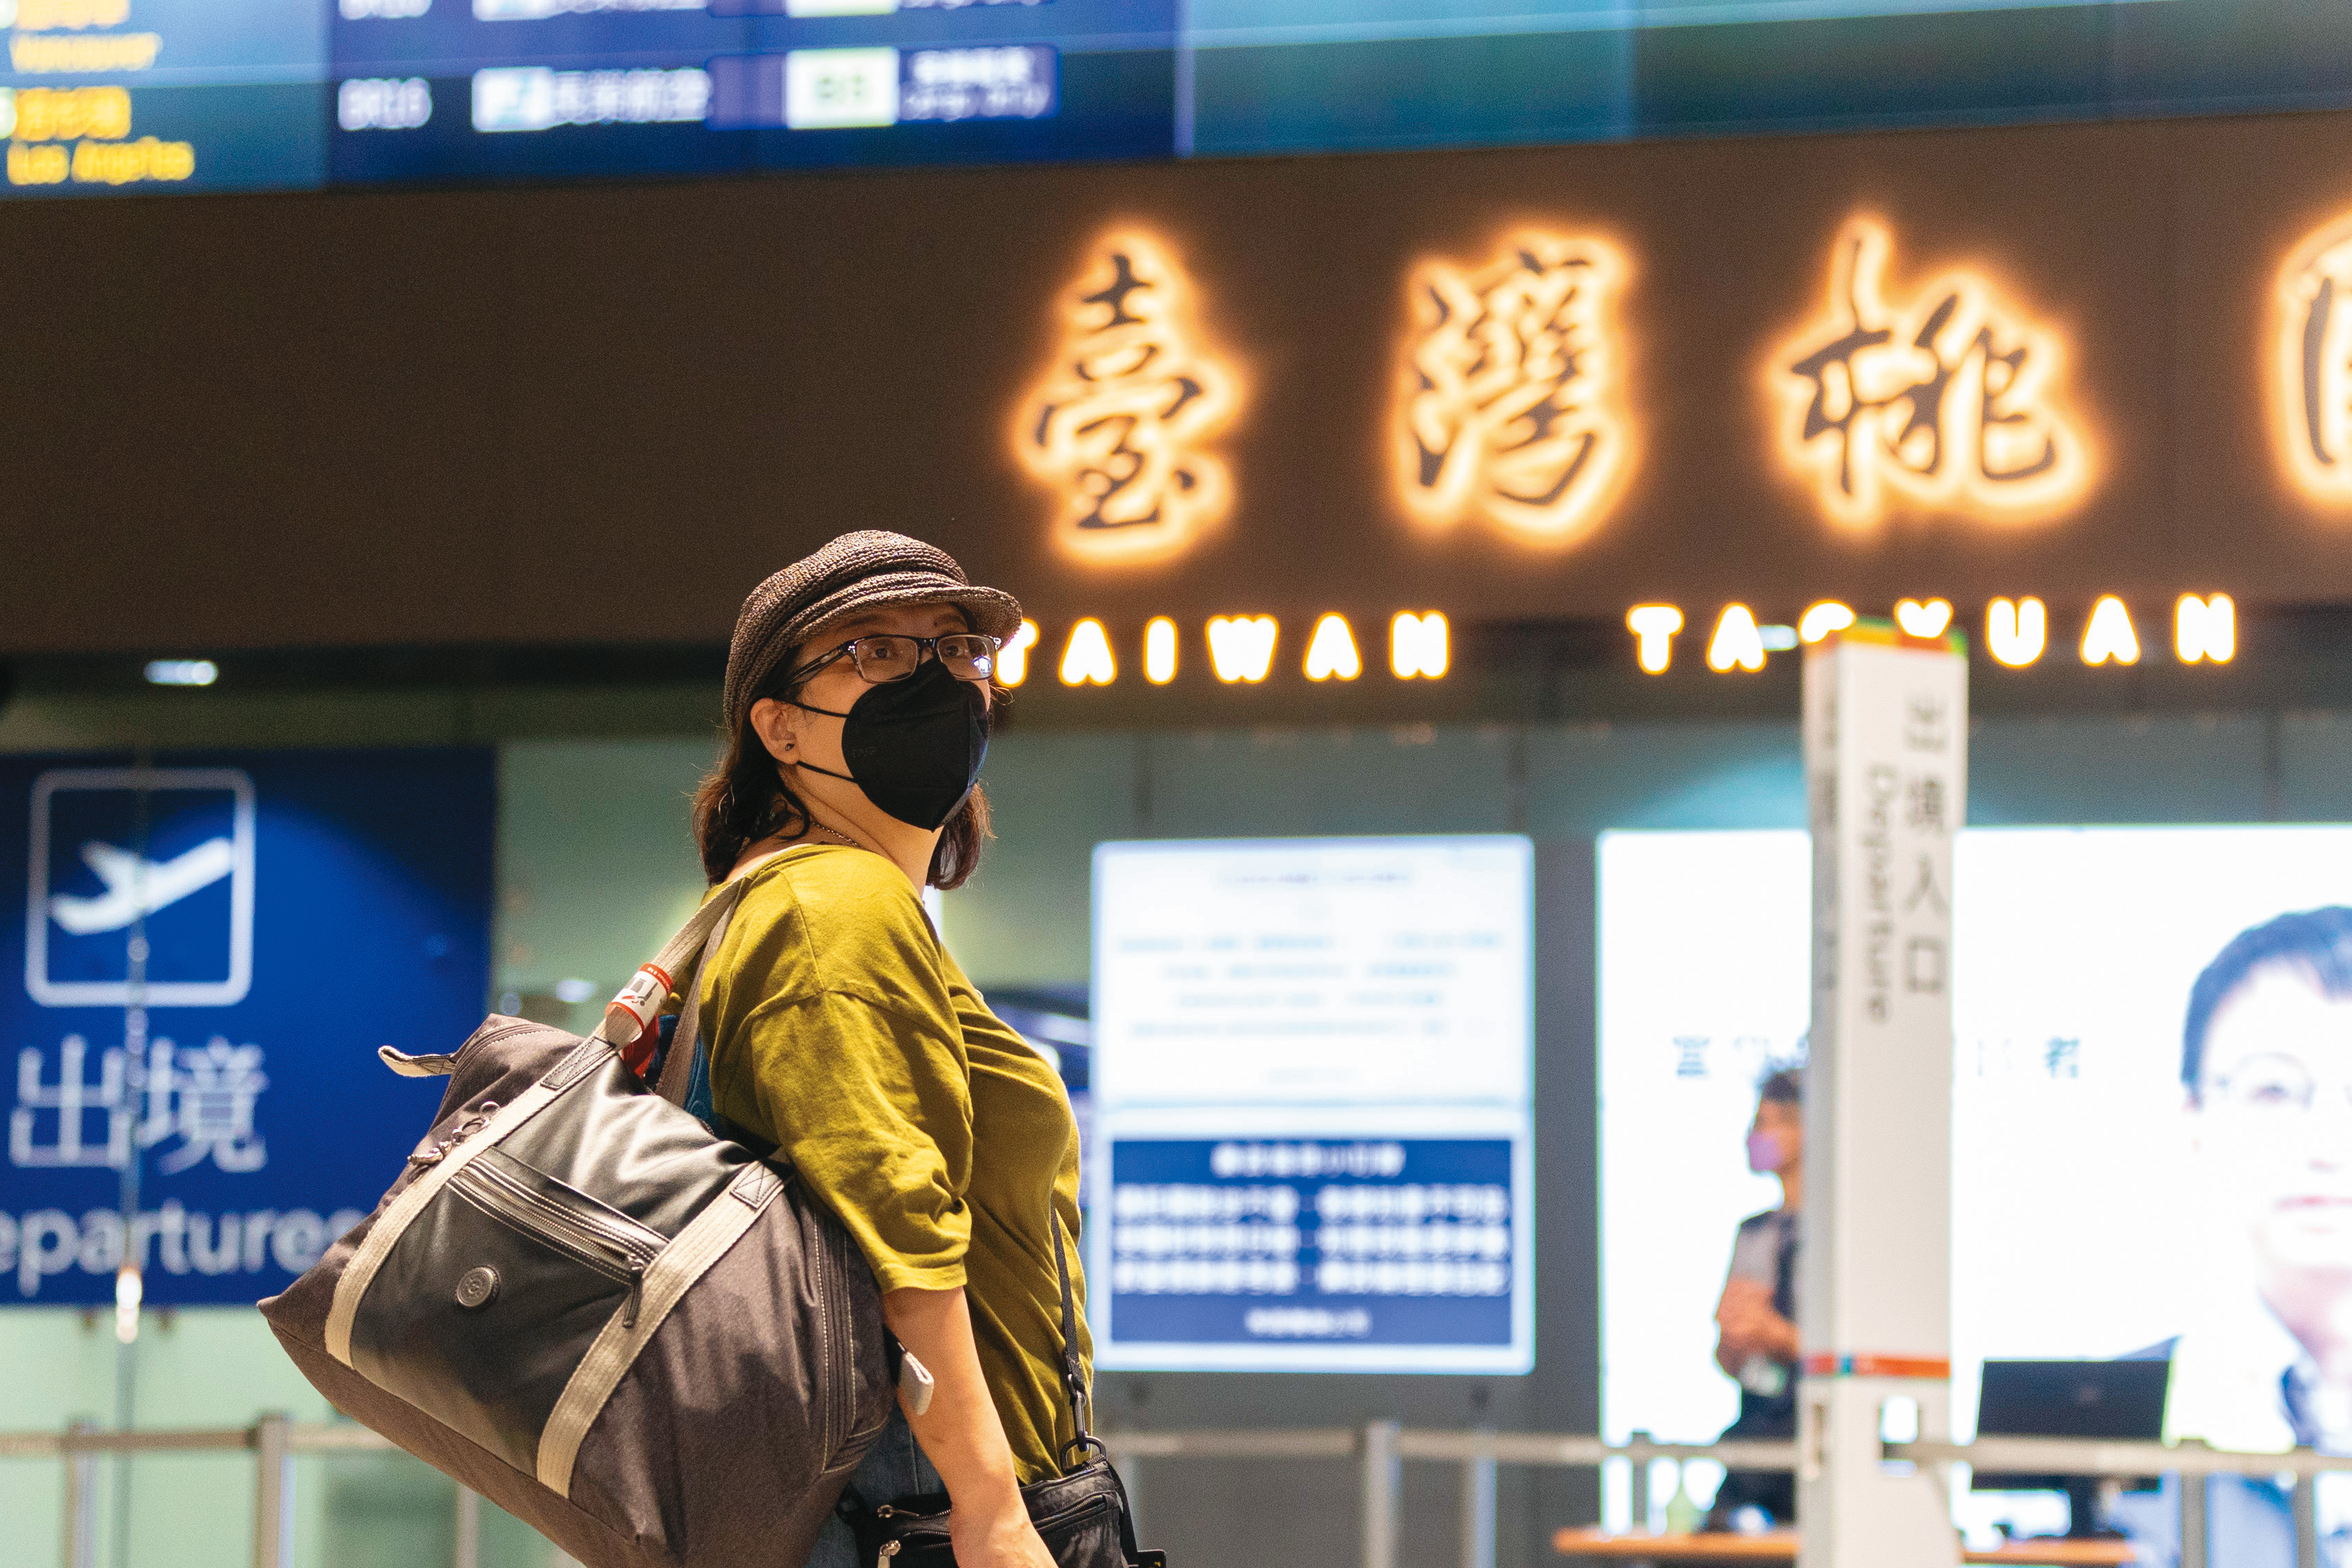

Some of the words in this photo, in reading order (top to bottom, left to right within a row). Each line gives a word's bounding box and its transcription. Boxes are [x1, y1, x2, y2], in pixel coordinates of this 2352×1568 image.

[994, 610, 1449, 687] TAIWAN
[1906, 697, 1948, 995] 出境入口
[9, 1034, 268, 1175] 出境
